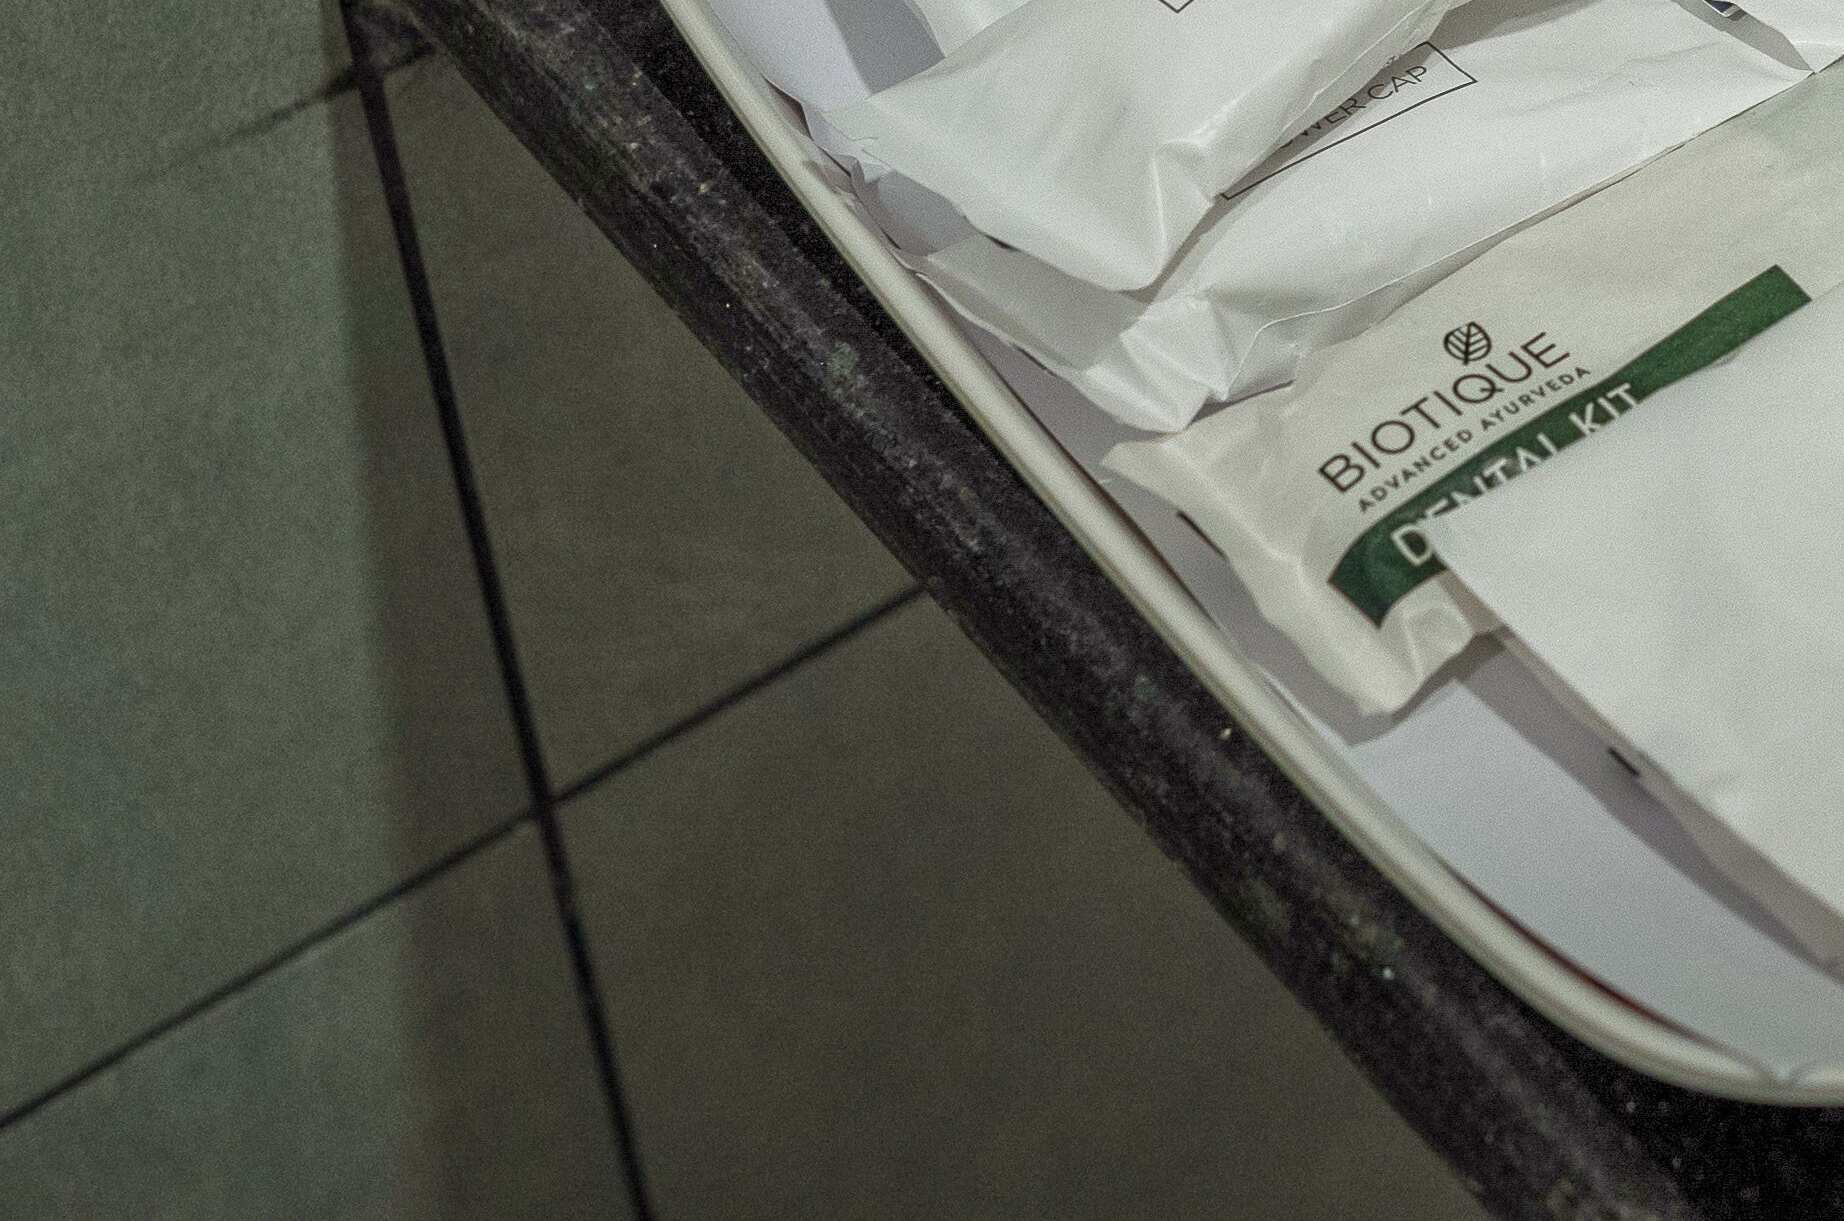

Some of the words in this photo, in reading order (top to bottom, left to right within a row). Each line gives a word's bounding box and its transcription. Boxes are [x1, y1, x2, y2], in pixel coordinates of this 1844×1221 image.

[1367, 65, 1427, 100] CAP
[1318, 331, 1571, 494] BIOTIQUE
[1358, 428, 1473, 514] ADVANCED
[1480, 366, 1591, 431] AYURVEDA
[1568, 382, 1641, 436] KIT
